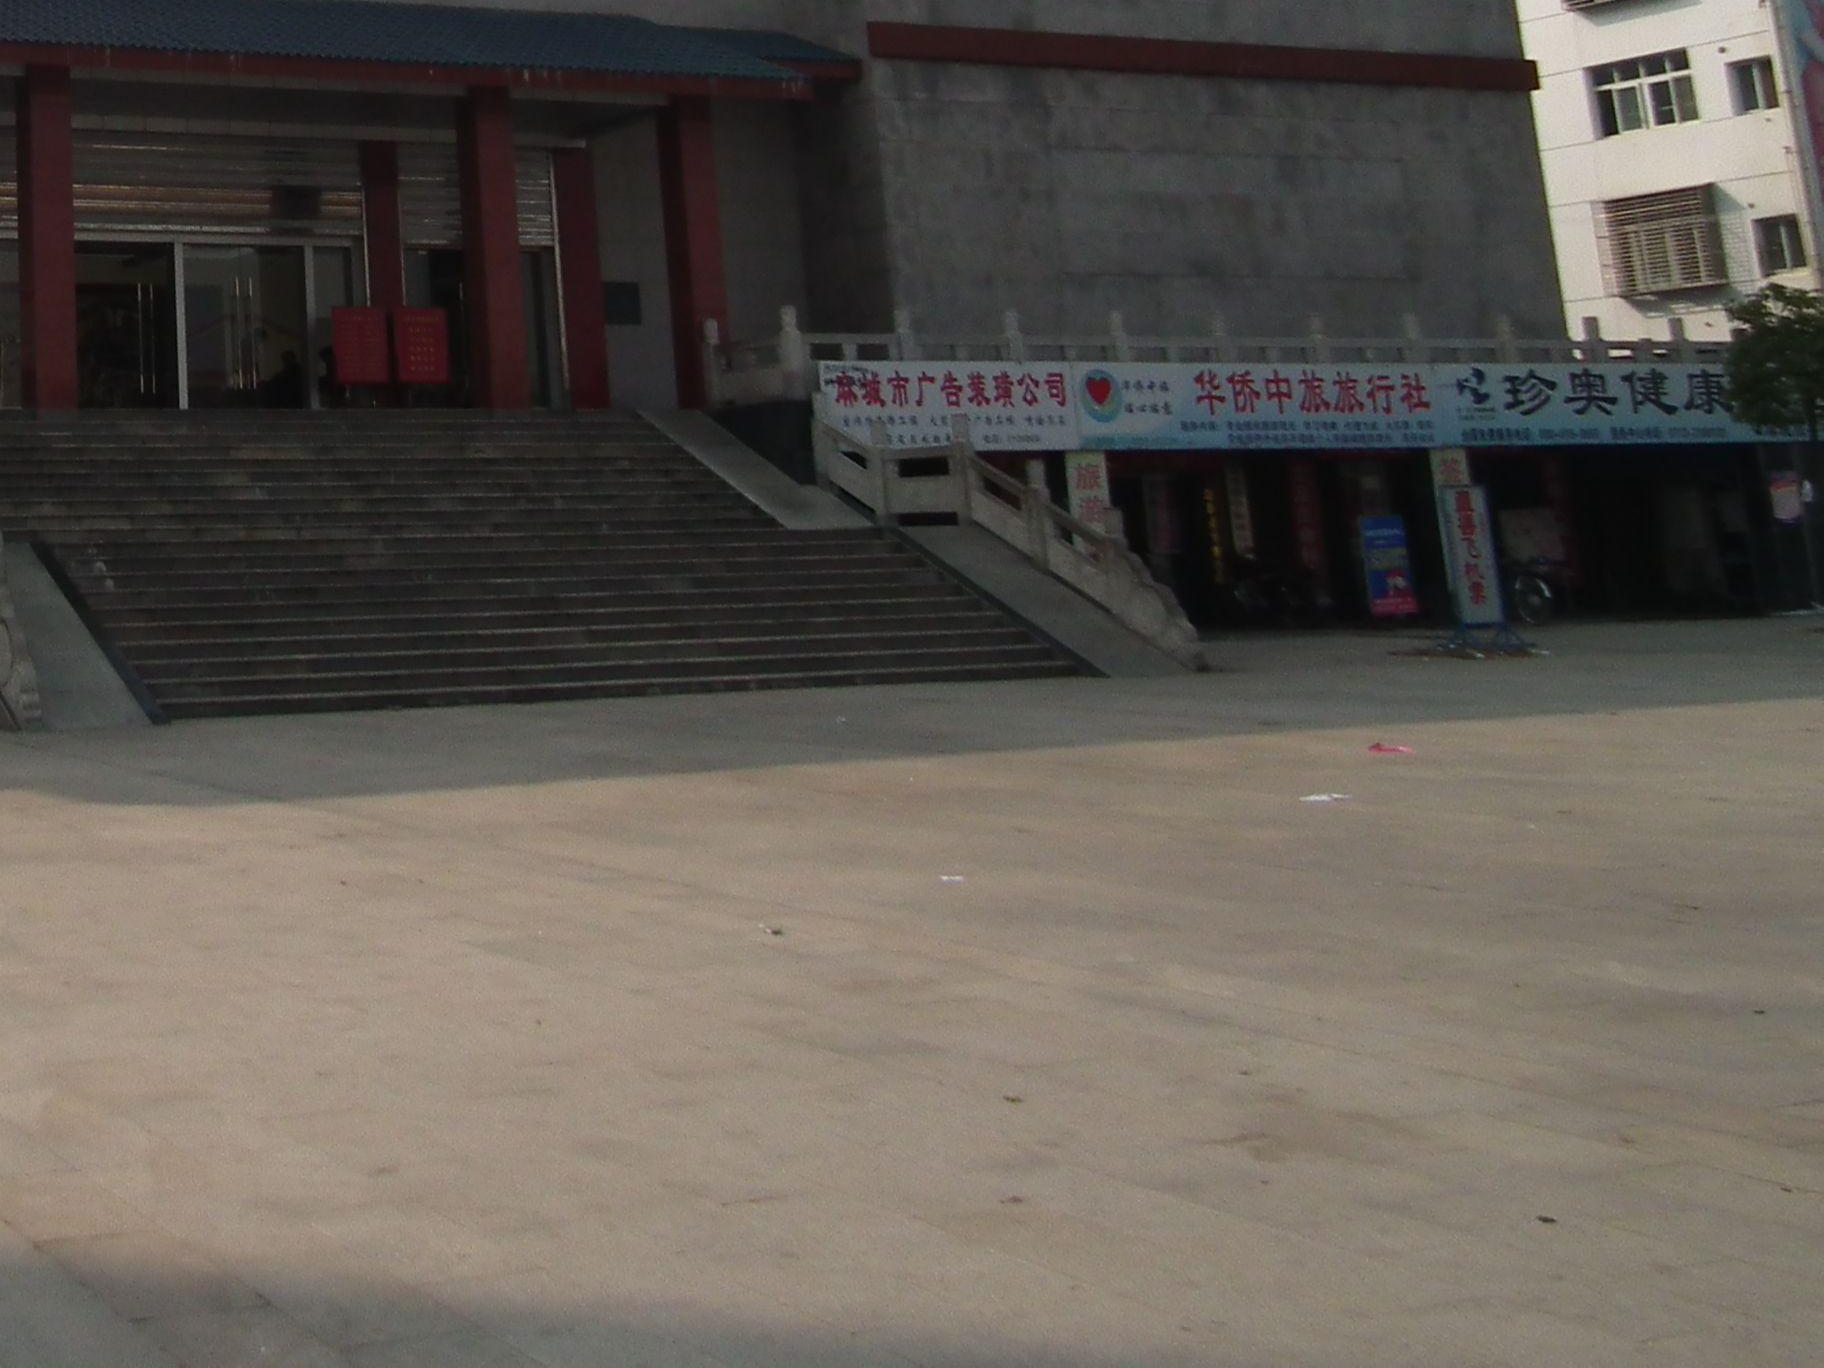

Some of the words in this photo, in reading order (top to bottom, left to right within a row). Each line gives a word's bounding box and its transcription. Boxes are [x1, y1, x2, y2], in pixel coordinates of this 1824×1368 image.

[1194, 369, 1431, 416] 华侨中旅旅行社
[1503, 368, 1734, 416] 珍奥健康
